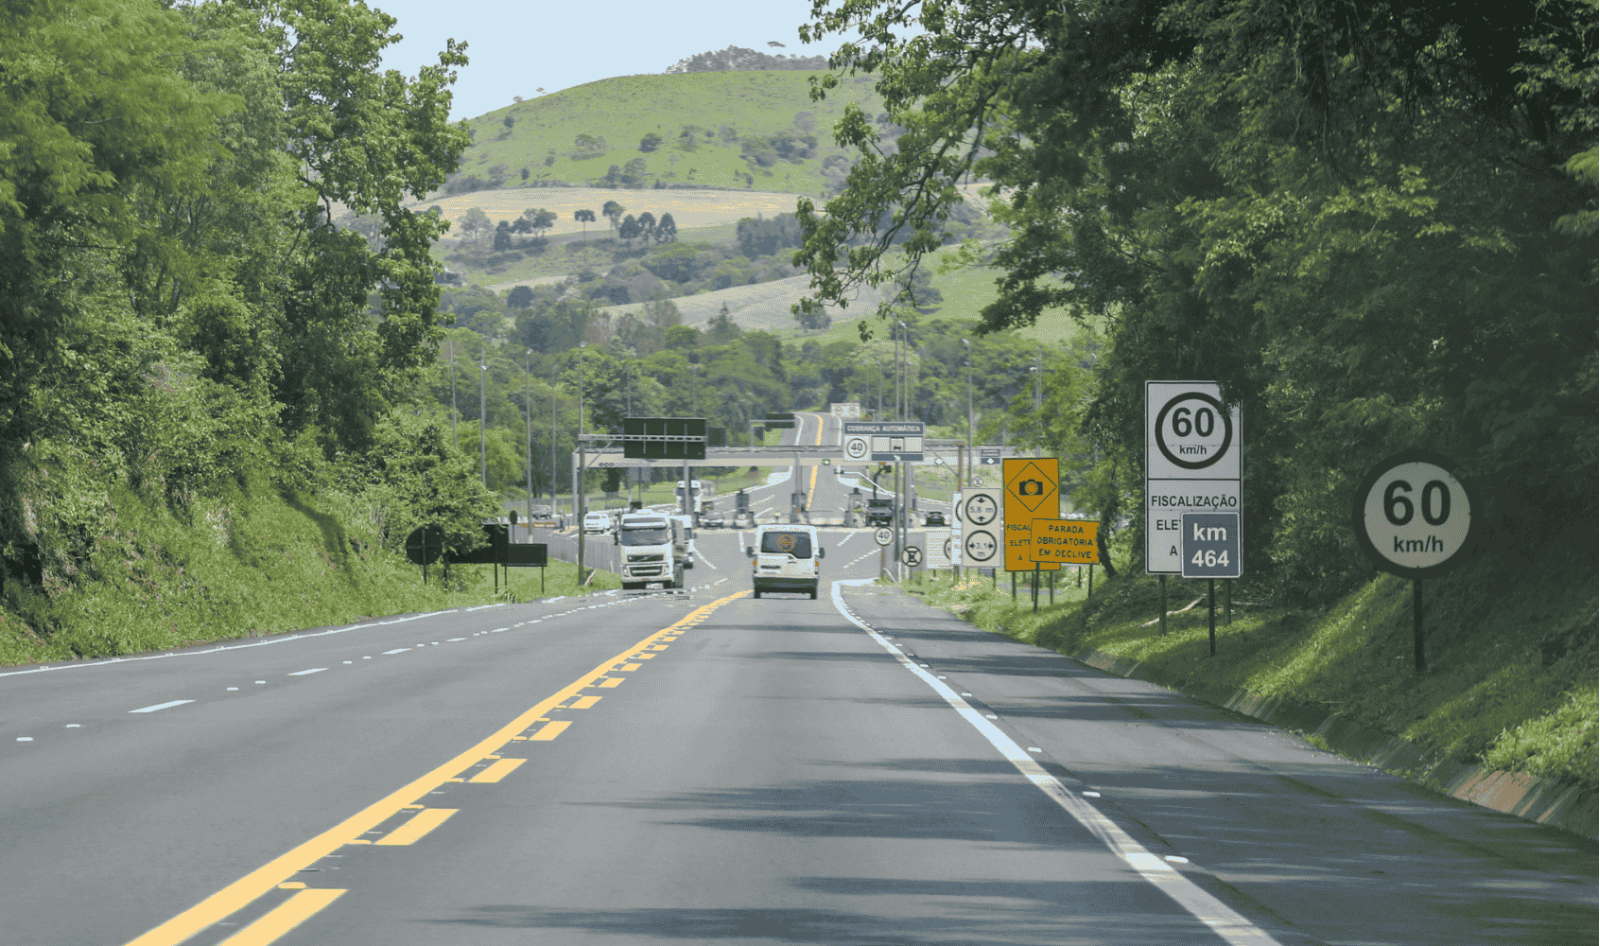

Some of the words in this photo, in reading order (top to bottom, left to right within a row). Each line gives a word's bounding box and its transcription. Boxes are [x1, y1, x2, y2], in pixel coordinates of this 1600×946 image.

[1172, 407, 1214, 437] 60
[882, 424, 921, 432] AUTOMÁTICA
[851, 442, 863, 451] 40
[1179, 445, 1207, 455] km/h
[1151, 494, 1237, 510] FISCALIZAÇÃO
[1383, 479, 1451, 526] 60
[1048, 525, 1084, 534] PARADA
[1156, 519, 1181, 531] ELE
[878, 531, 890, 539] 40
[1193, 522, 1227, 541] km
[1037, 537, 1093, 546] OBRIGATÓRIA
[1394, 535, 1444, 552] km/h
[1039, 548, 1051, 557] EM
[1054, 549, 1092, 558] DECLIVE
[1169, 545, 1178, 556] A
[1191, 549, 1230, 567] 464
